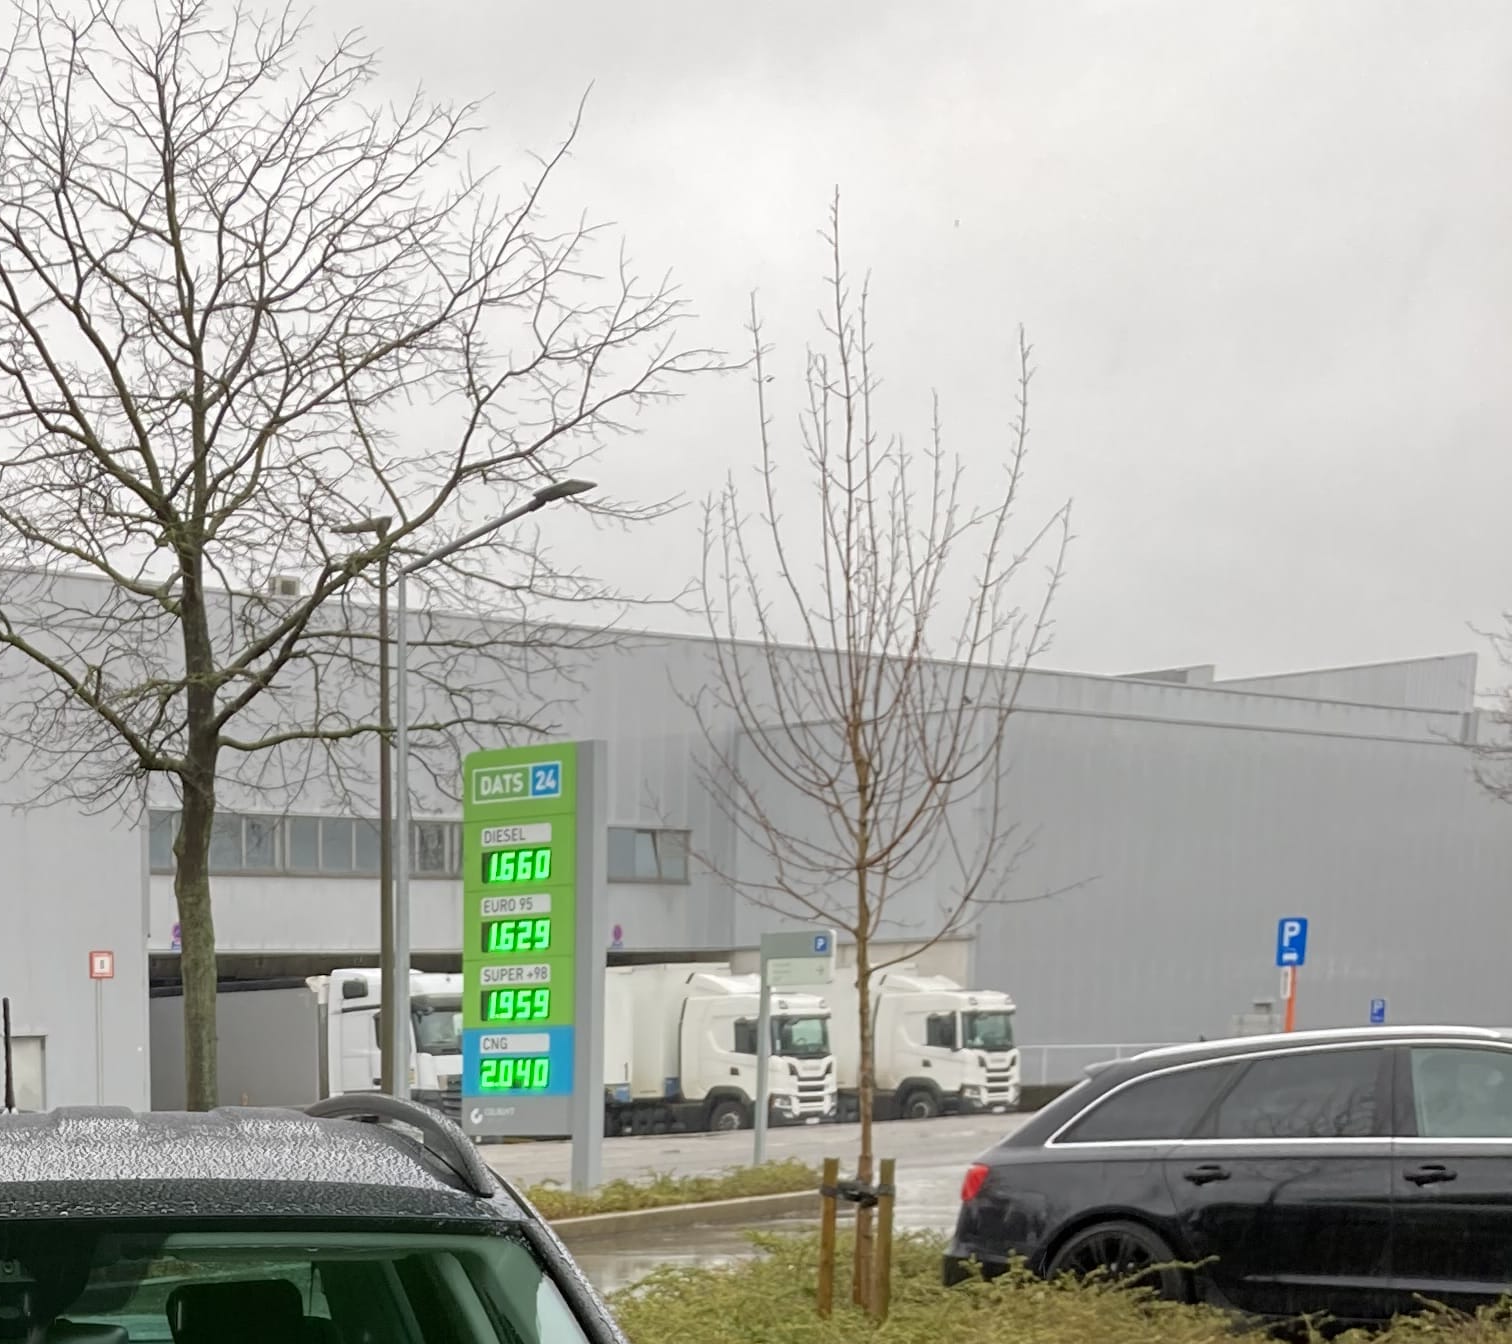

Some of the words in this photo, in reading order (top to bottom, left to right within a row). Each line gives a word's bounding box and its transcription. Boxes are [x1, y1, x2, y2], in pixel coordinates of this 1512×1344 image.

[480, 772, 524, 796] DATS
[535, 769, 557, 791] 24
[483, 828, 526, 844] DIESEL
[483, 898, 517, 914] EURO
[519, 896, 534, 911] 95
[1282, 921, 1301, 947] P
[483, 967, 524, 983] SUPER
[482, 1037, 508, 1051] CNG
